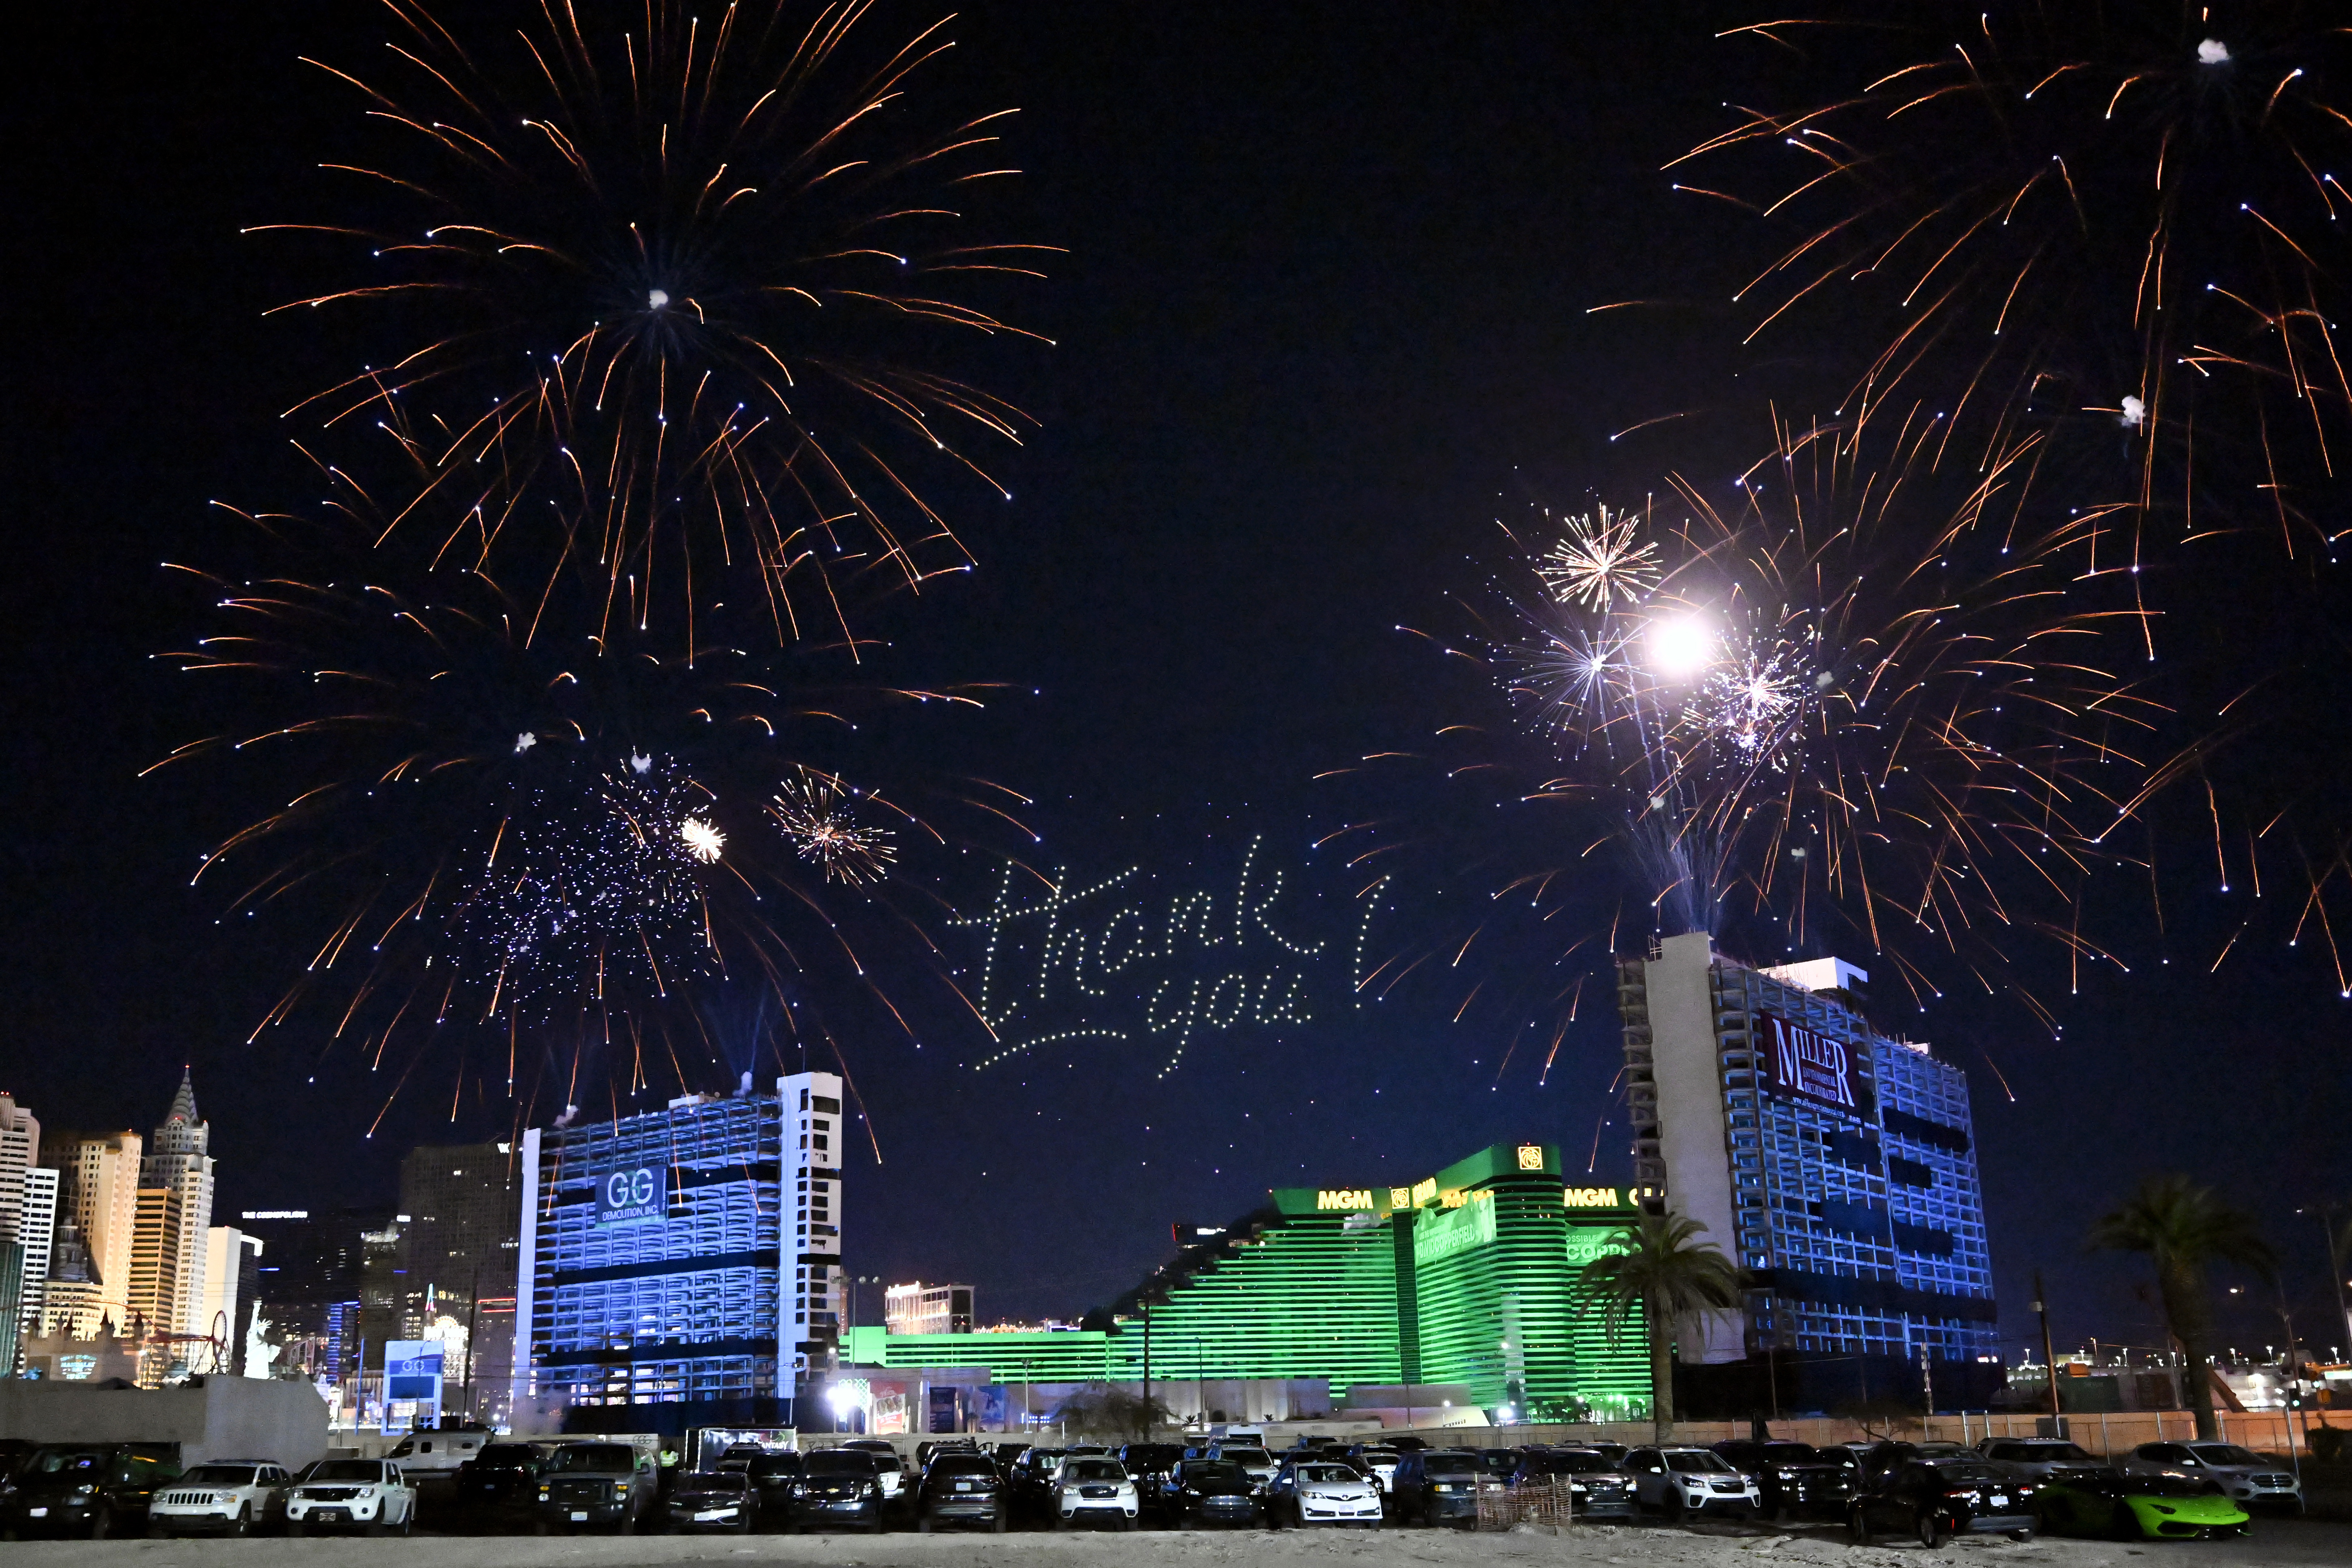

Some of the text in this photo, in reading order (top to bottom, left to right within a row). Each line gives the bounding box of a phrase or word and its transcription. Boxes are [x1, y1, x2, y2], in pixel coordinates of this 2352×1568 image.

[1318, 1191, 1373, 1209] MGM
[1414, 1177, 1437, 1204] GRAND
[1564, 1188, 1618, 1207] MGM
[645, 1205, 659, 1215] INC.
